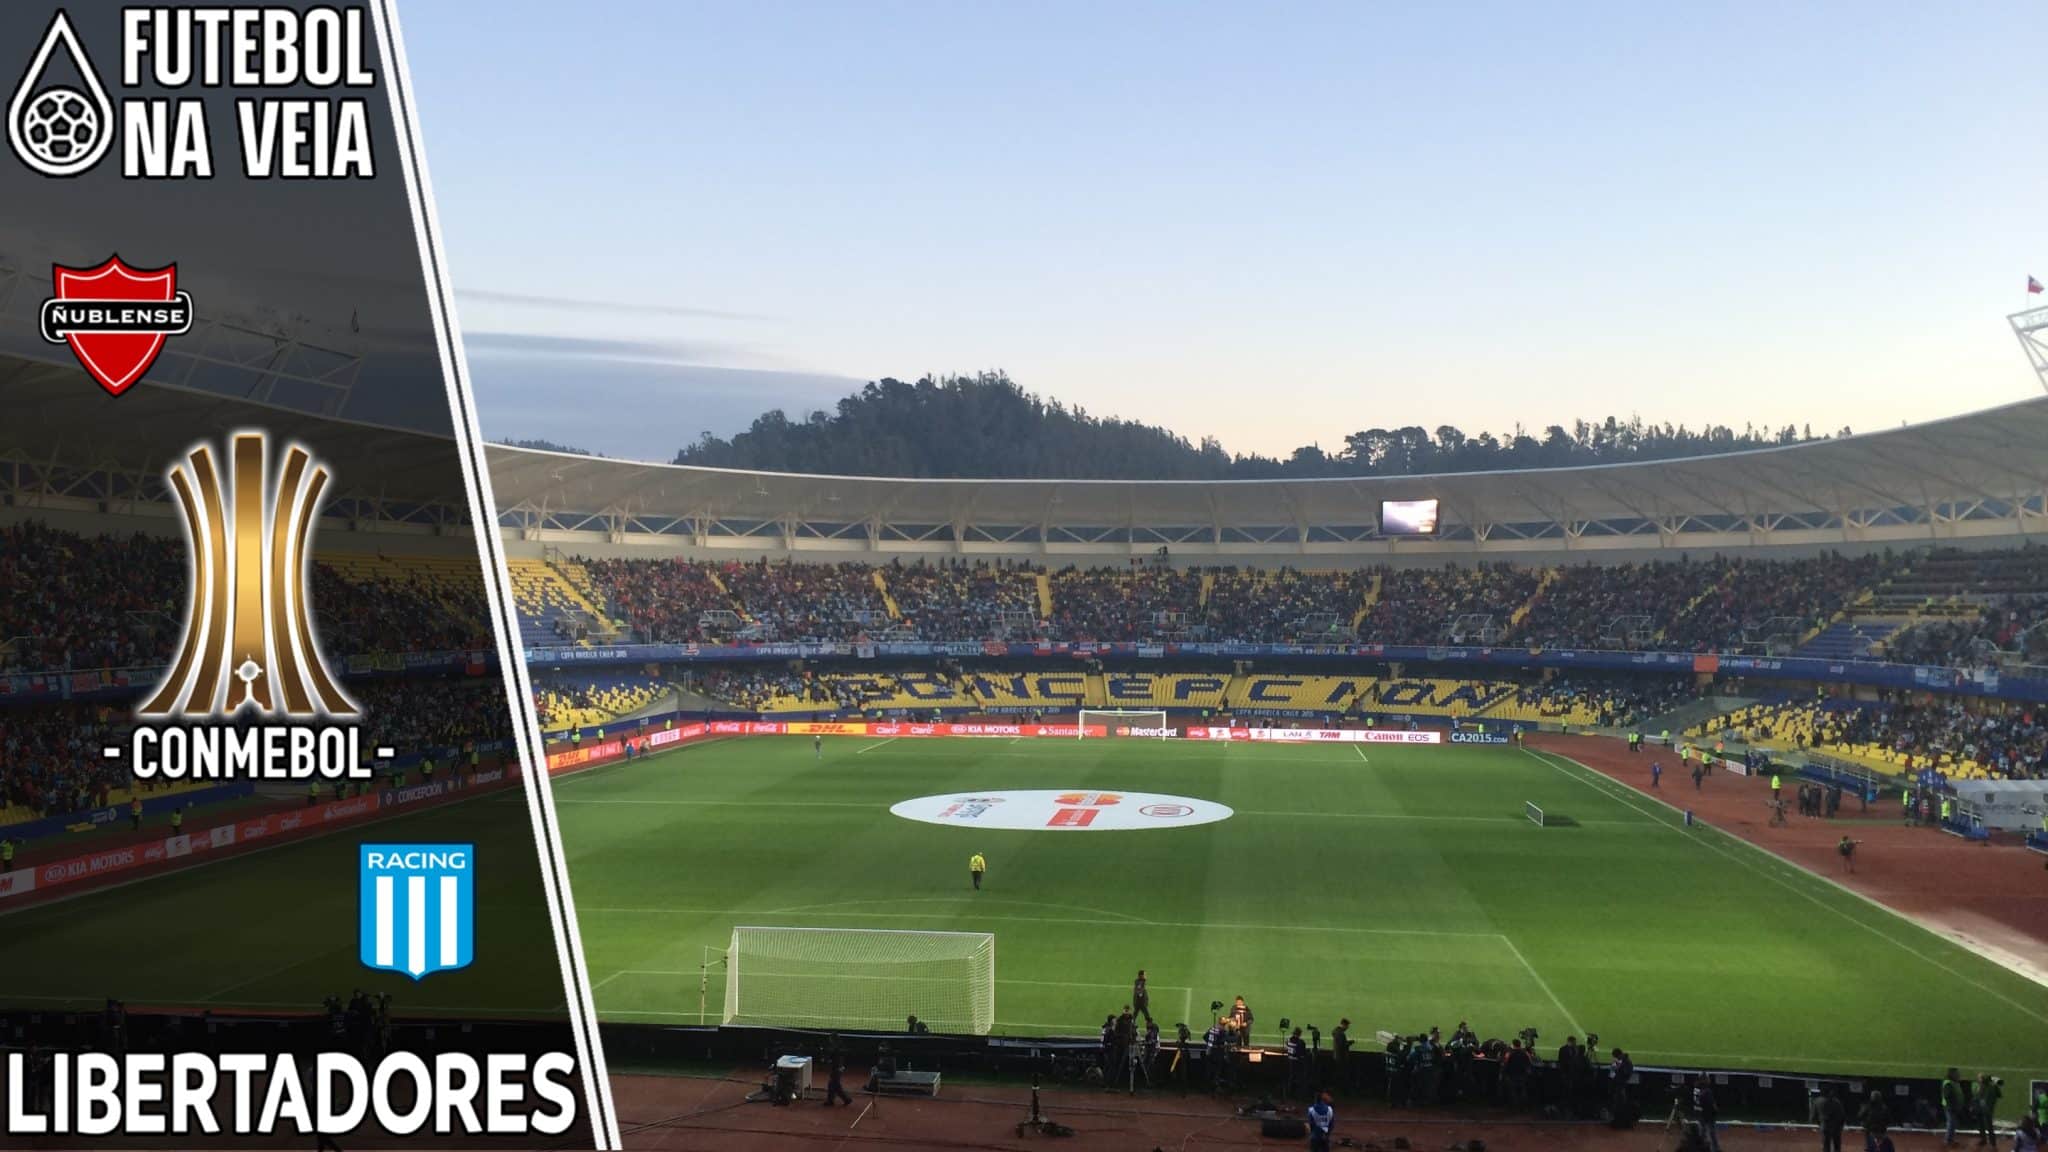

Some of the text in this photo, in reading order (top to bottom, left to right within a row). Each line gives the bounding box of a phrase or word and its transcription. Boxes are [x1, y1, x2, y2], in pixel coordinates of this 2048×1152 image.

[807, 724, 847, 734] DHL
[967, 726, 983, 734] KIA
[984, 725, 1020, 735] MOTORS
[1047, 726, 1093, 736] Santander
[1130, 726, 1178, 738] MasterCard
[1319, 731, 1341, 740] TAM
[1364, 731, 1430, 742] Canon EOS
[67, 862, 87, 877] KIA
[89, 850, 135, 873] MOTORS
